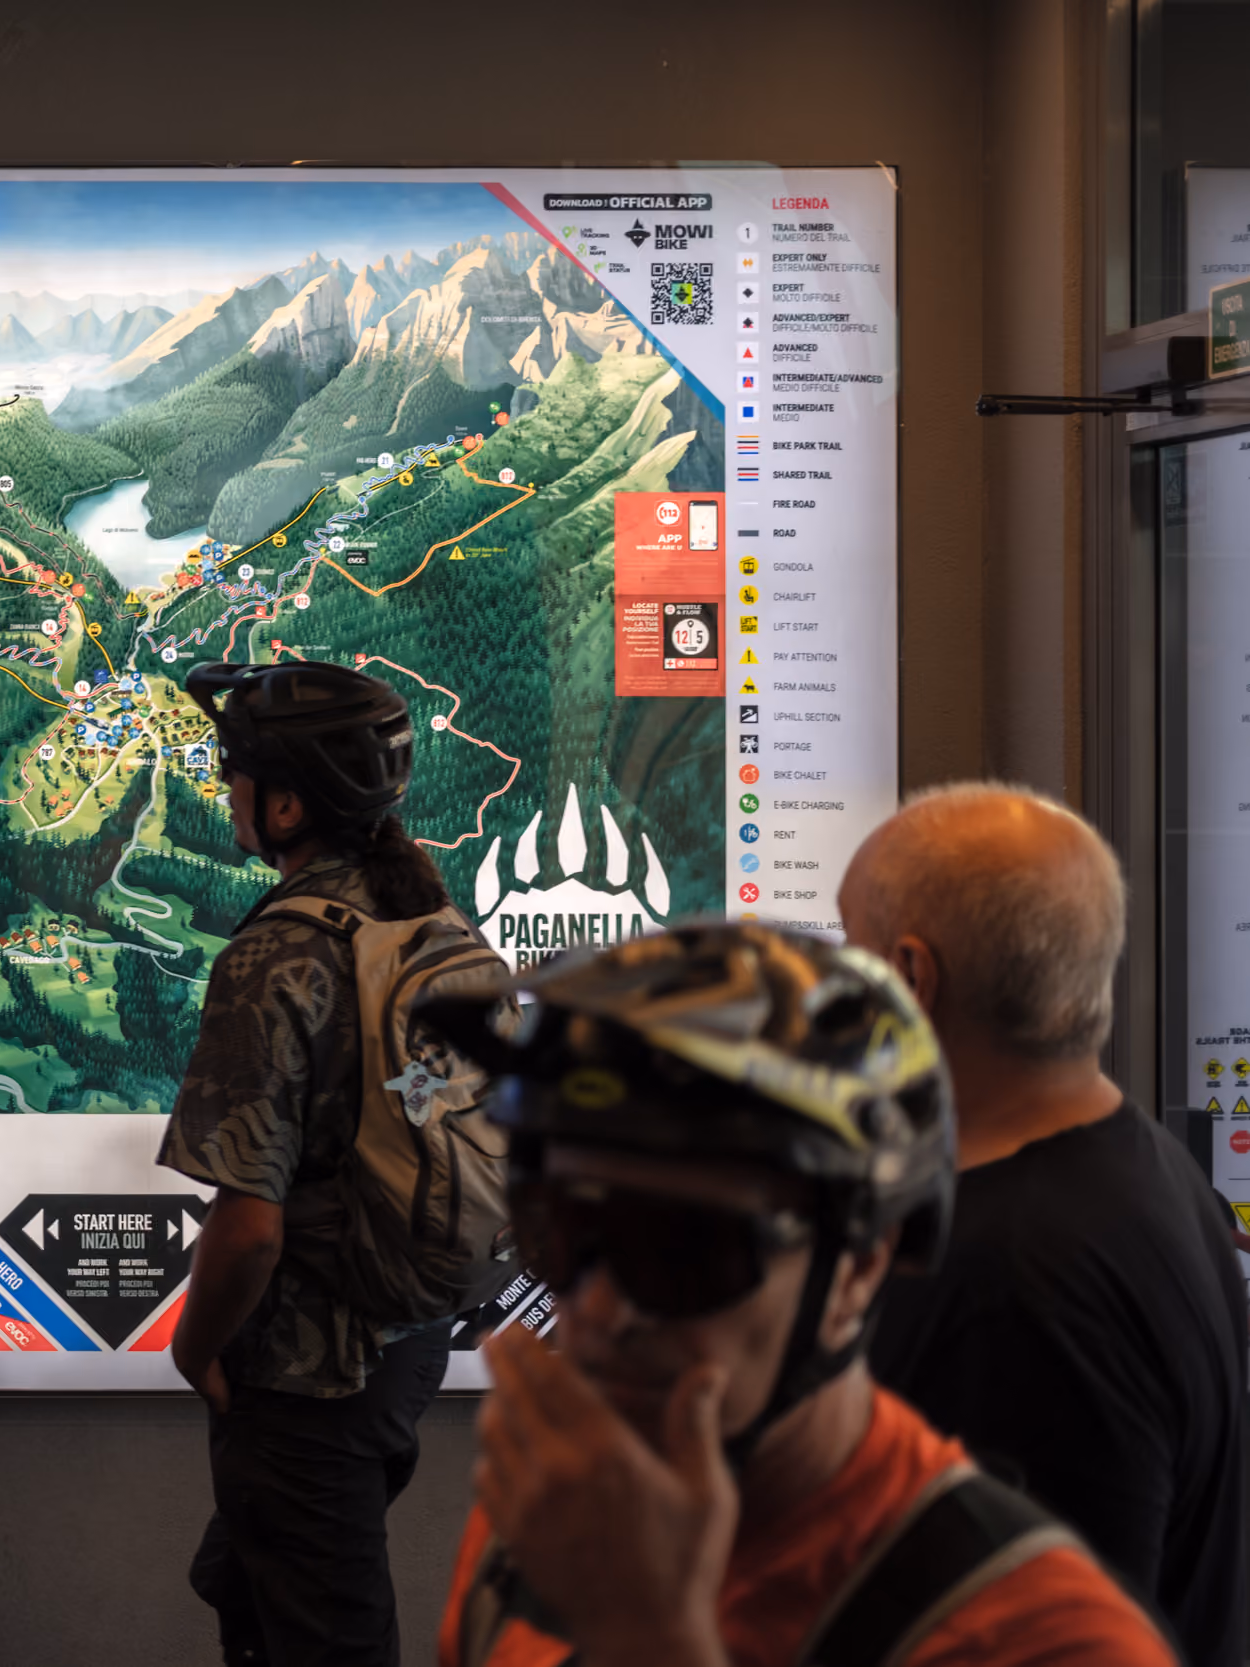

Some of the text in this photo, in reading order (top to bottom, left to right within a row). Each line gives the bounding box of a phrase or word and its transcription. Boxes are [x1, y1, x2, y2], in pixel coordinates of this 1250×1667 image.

[550, 197, 707, 208] DOWNLOAD OFFICIAL APP
[772, 198, 830, 210] LEGENDA
[655, 225, 713, 238] MOWI
[772, 224, 797, 232] TRAIL
[799, 223, 834, 232] NUMBER
[772, 233, 851, 242] NUMERO DEL TRAIL
[655, 240, 688, 250] BIKE
[772, 254, 827, 262] EXPERT ONLY
[772, 263, 881, 273] ESTREMAMENTE DIFFICILE
[772, 284, 804, 292] EXPERT
[772, 294, 841, 302] MOLTO DIFFICILE
[773, 314, 850, 322] ADVANCED/EXPERT
[773, 324, 878, 333] DIFFICILE/MOLTO DIFFICILE
[773, 344, 818, 352] ADVANCED
[773, 354, 811, 362] DIFFICILE
[772, 374, 883, 383] INTERMEDIATE/ADVANCED
[772, 384, 840, 392] MEDIO DIFFICILE
[772, 404, 834, 412] INTERMEDIATE
[773, 414, 799, 422] MEDIO
[772, 442, 842, 450] BIKE PARK TRAIL
[773, 471, 832, 479] SHARED TRAIL
[0, 480, 12, 488] 805
[773, 500, 816, 508] FIRE ROAD
[663, 509, 677, 518] 112
[773, 529, 796, 537] ROAD
[658, 534, 682, 543] APP
[773, 563, 814, 571] GONDOLA
[773, 593, 816, 601] CHAIRLIFT
[773, 623, 818, 631] LIFT START
[675, 630, 688, 644] 12
[696, 630, 703, 644] 5
[773, 653, 837, 662] PAY ATTENTION
[774, 683, 836, 692] FARM ANIMALS
[774, 712, 841, 721] UPHILL SECTION
[774, 743, 812, 751] PORTAGE
[774, 771, 827, 780] BIKE CHALET
[774, 801, 845, 810] E-BIKE CHARGING
[774, 831, 796, 839] RENT
[774, 860, 819, 869] BIKE WASH
[774, 890, 817, 899] BIKE SHOP
[826, 921, 846, 930] ARE
[74, 1214, 153, 1230] START HERE
[81, 1233, 145, 1249] INIZIA QUI
[495, 1274, 532, 1310] MONTE
[520, 1307, 545, 1331] BUS
